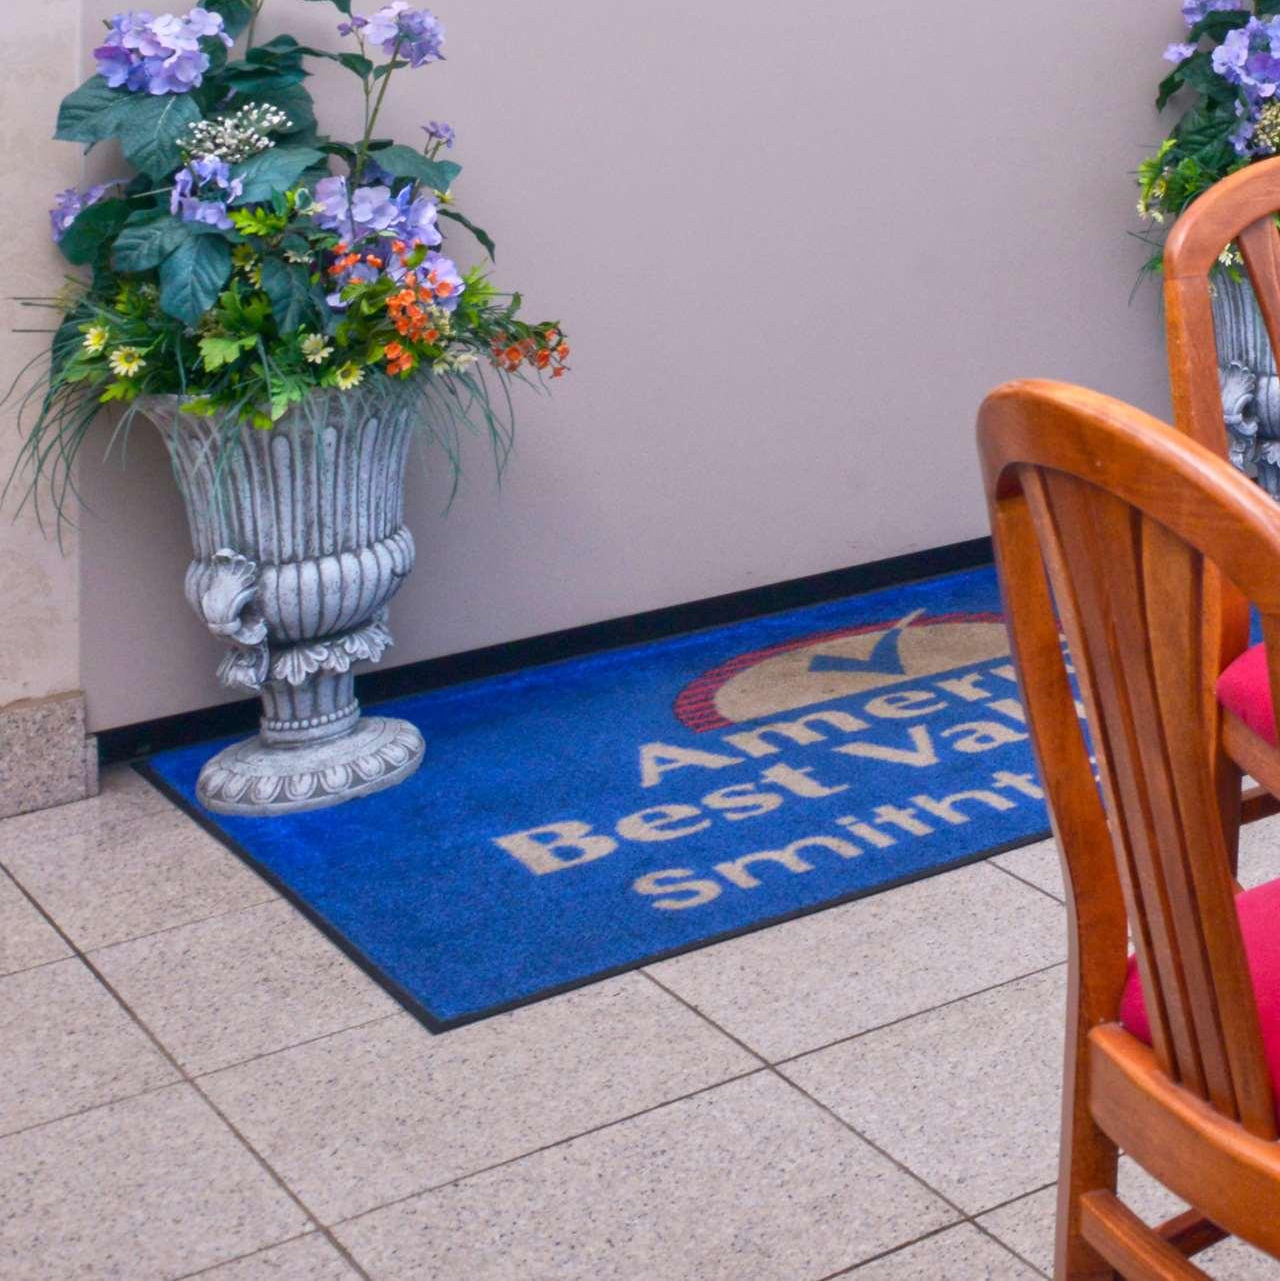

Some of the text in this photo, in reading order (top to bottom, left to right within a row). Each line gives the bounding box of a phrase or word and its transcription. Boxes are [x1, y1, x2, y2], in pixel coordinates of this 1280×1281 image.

[491, 698, 1030, 876] Best Val
[631, 771, 1046, 910] Smitht
